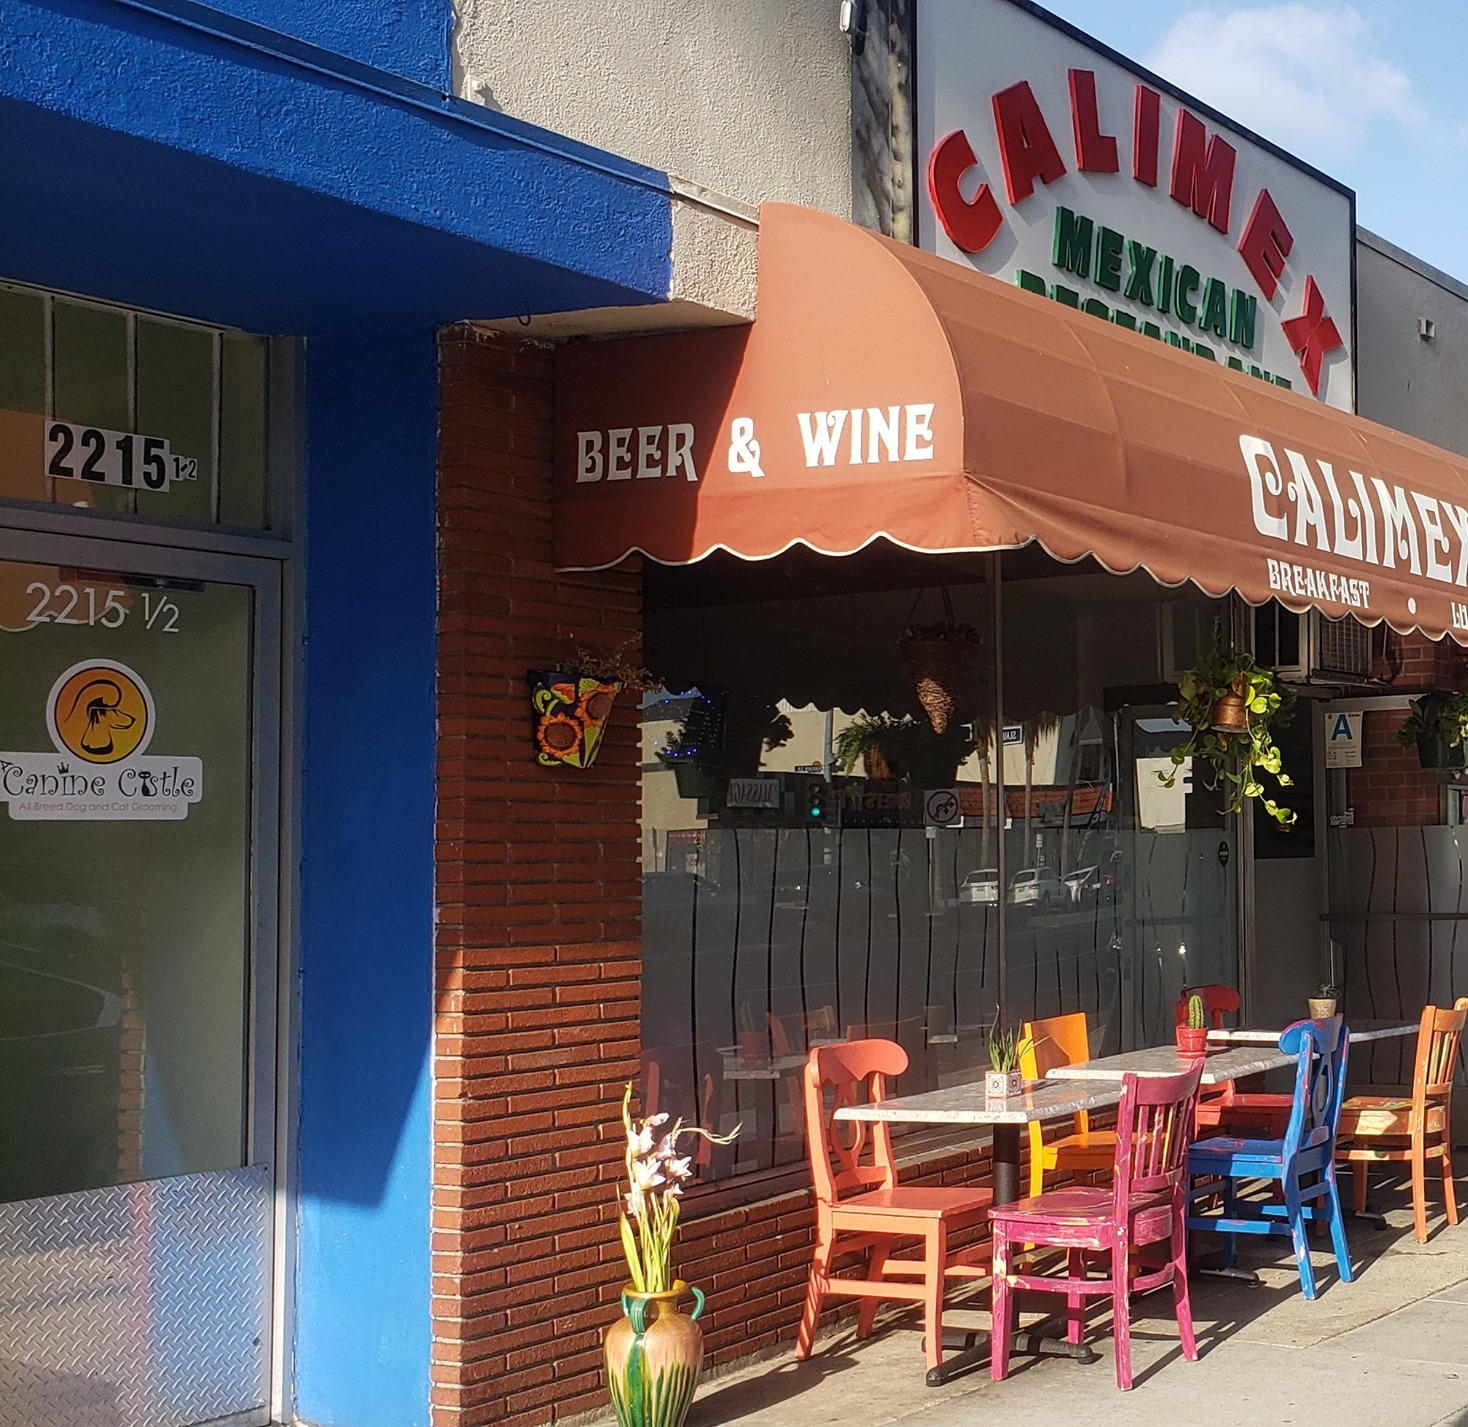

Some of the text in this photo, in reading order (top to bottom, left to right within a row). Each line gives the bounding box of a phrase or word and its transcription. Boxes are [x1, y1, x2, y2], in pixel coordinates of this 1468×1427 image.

[928, 68, 1343, 395] CALIMEX
[1052, 206, 1257, 348] MEXICAN
[48, 424, 166, 489] 2215
[576, 403, 935, 484] BEER & WINE
[25, 582, 126, 629] 2215
[1267, 558, 1370, 609] BREAKFAST
[1331, 713, 1353, 741] A
[3, 763, 105, 797] Canine
[19, 802, 32, 811] All
[33, 802, 64, 811] Breed
[66, 803, 86, 813] Dog
[90, 803, 109, 812] and
[112, 803, 129, 812] Cat
